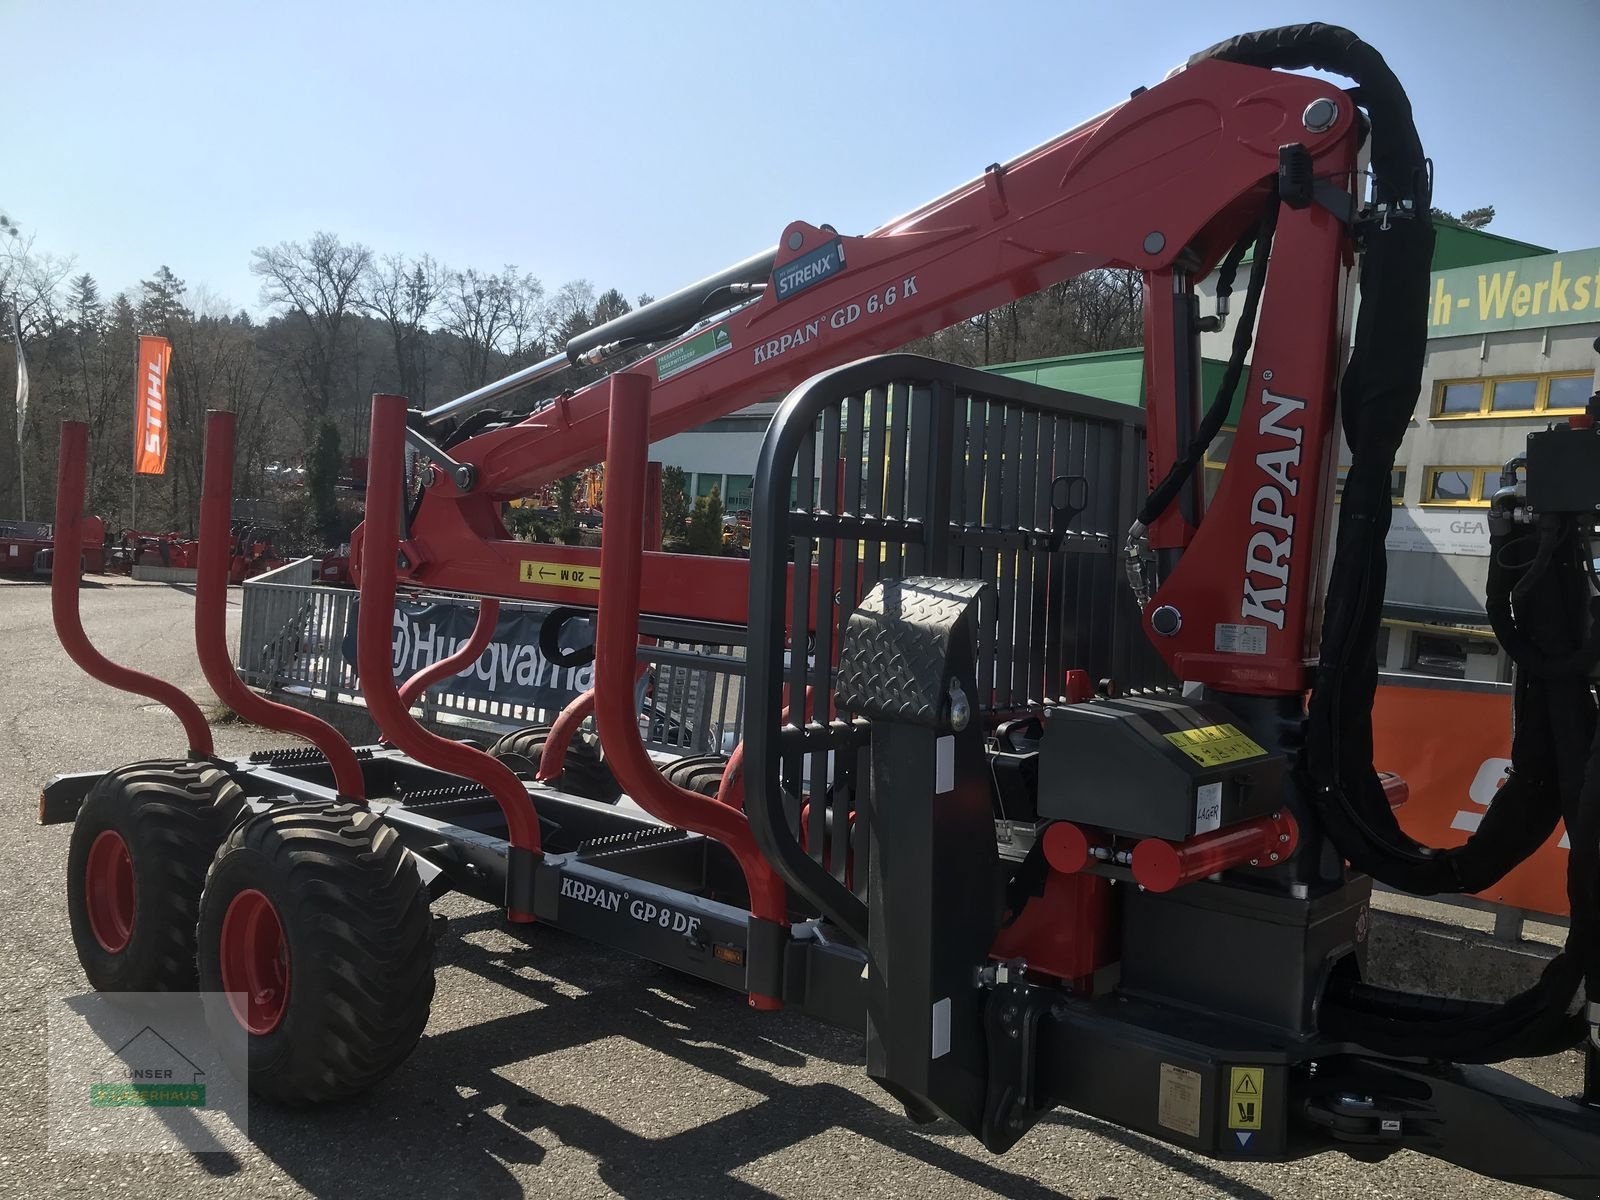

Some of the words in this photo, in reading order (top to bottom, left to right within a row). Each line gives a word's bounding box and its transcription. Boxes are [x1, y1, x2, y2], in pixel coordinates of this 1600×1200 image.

[779, 253, 831, 294] STRENX
[830, 302, 861, 330] GD
[903, 276, 918, 299] K
[144, 353, 163, 457] STIHL
[1449, 521, 1485, 534] GEA
[560, 569, 569, 581] M
[571, 570, 584, 582] 20
[1198, 804, 1219, 820] LAGER
[629, 899, 657, 922] GP
[658, 909, 670, 928] 8
